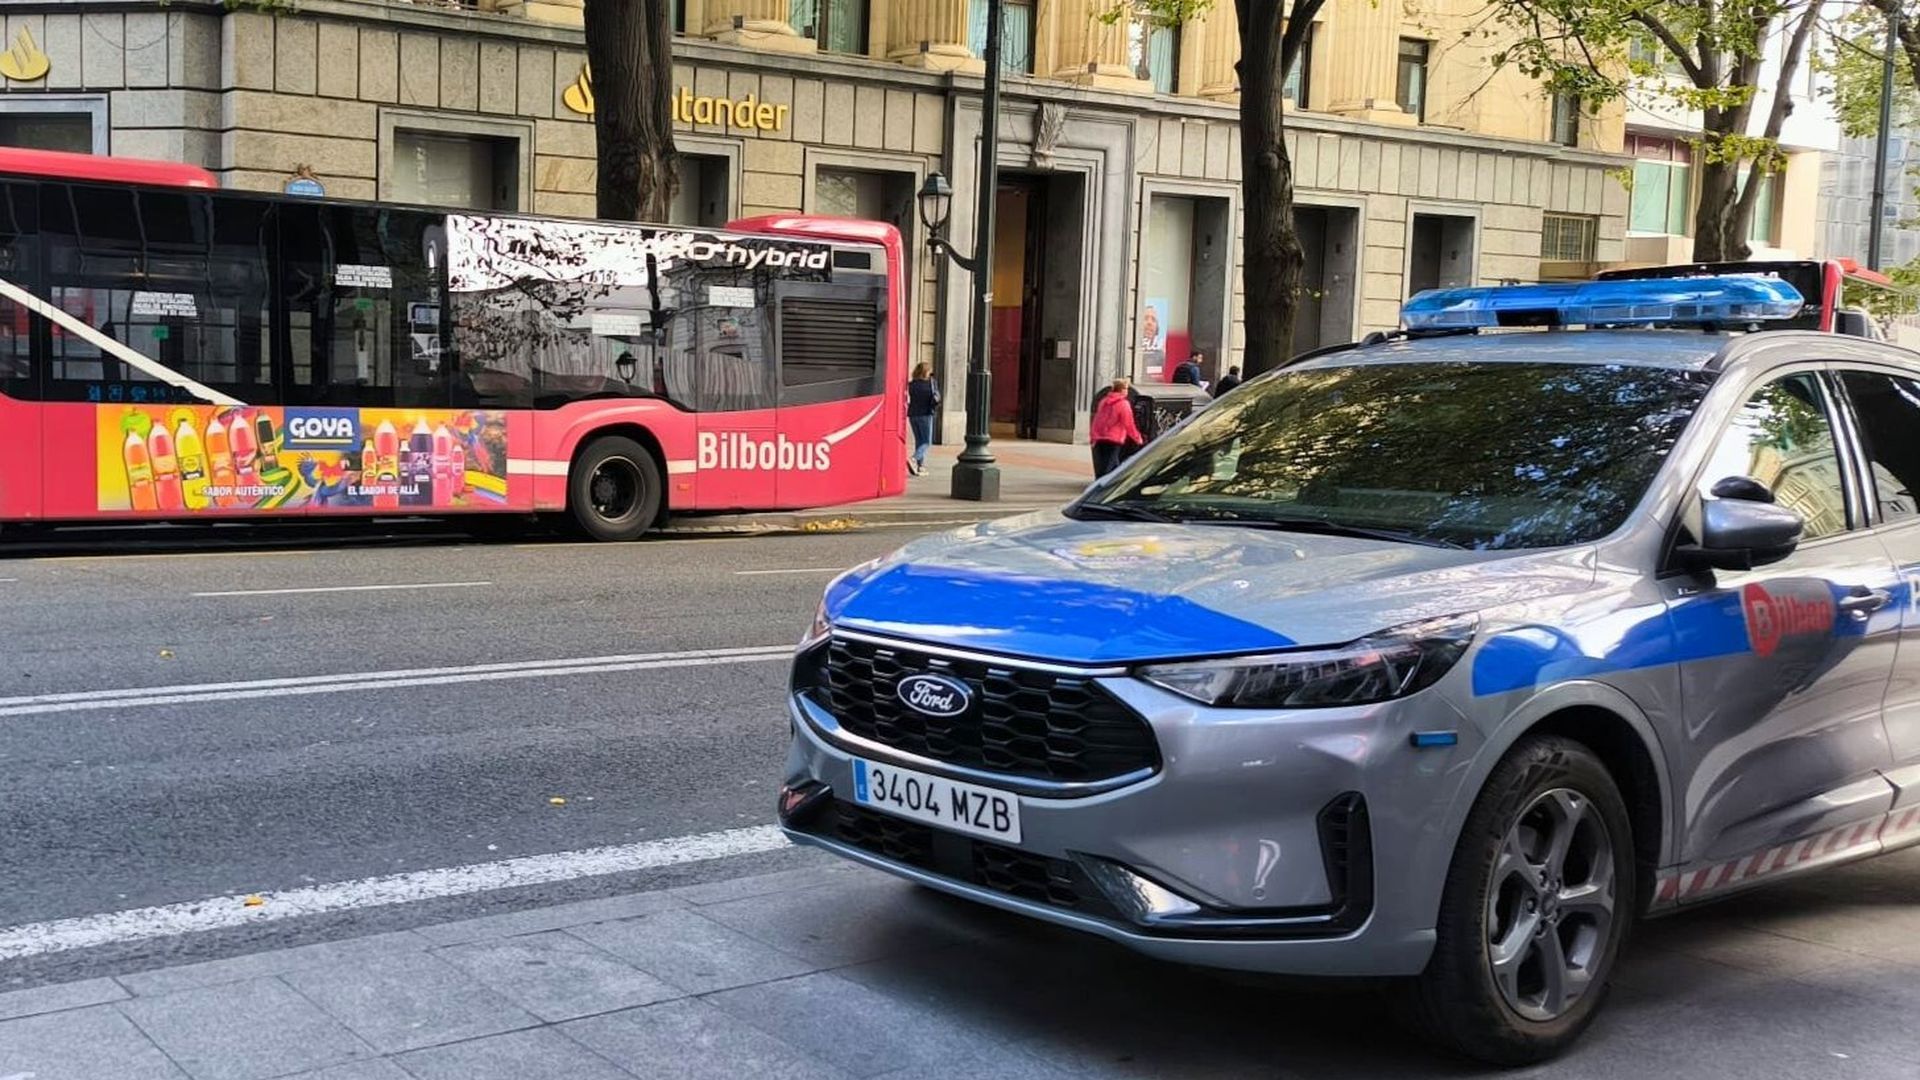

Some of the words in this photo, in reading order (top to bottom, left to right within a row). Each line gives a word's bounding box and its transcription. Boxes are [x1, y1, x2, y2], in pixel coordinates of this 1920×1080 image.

[672, 86, 788, 130] tander
[727, 245, 828, 270] hybrid
[289, 416, 353, 439] GOYA
[698, 431, 831, 471] Bilbobus
[202, 485, 233, 497] SABOR
[347, 485, 358, 496] EL
[359, 485, 386, 496] SABOR
[387, 485, 398, 496] DE
[909, 680, 954, 711] Ford
[872, 769, 940, 817] 3404
[952, 787, 1011, 833] MZB
